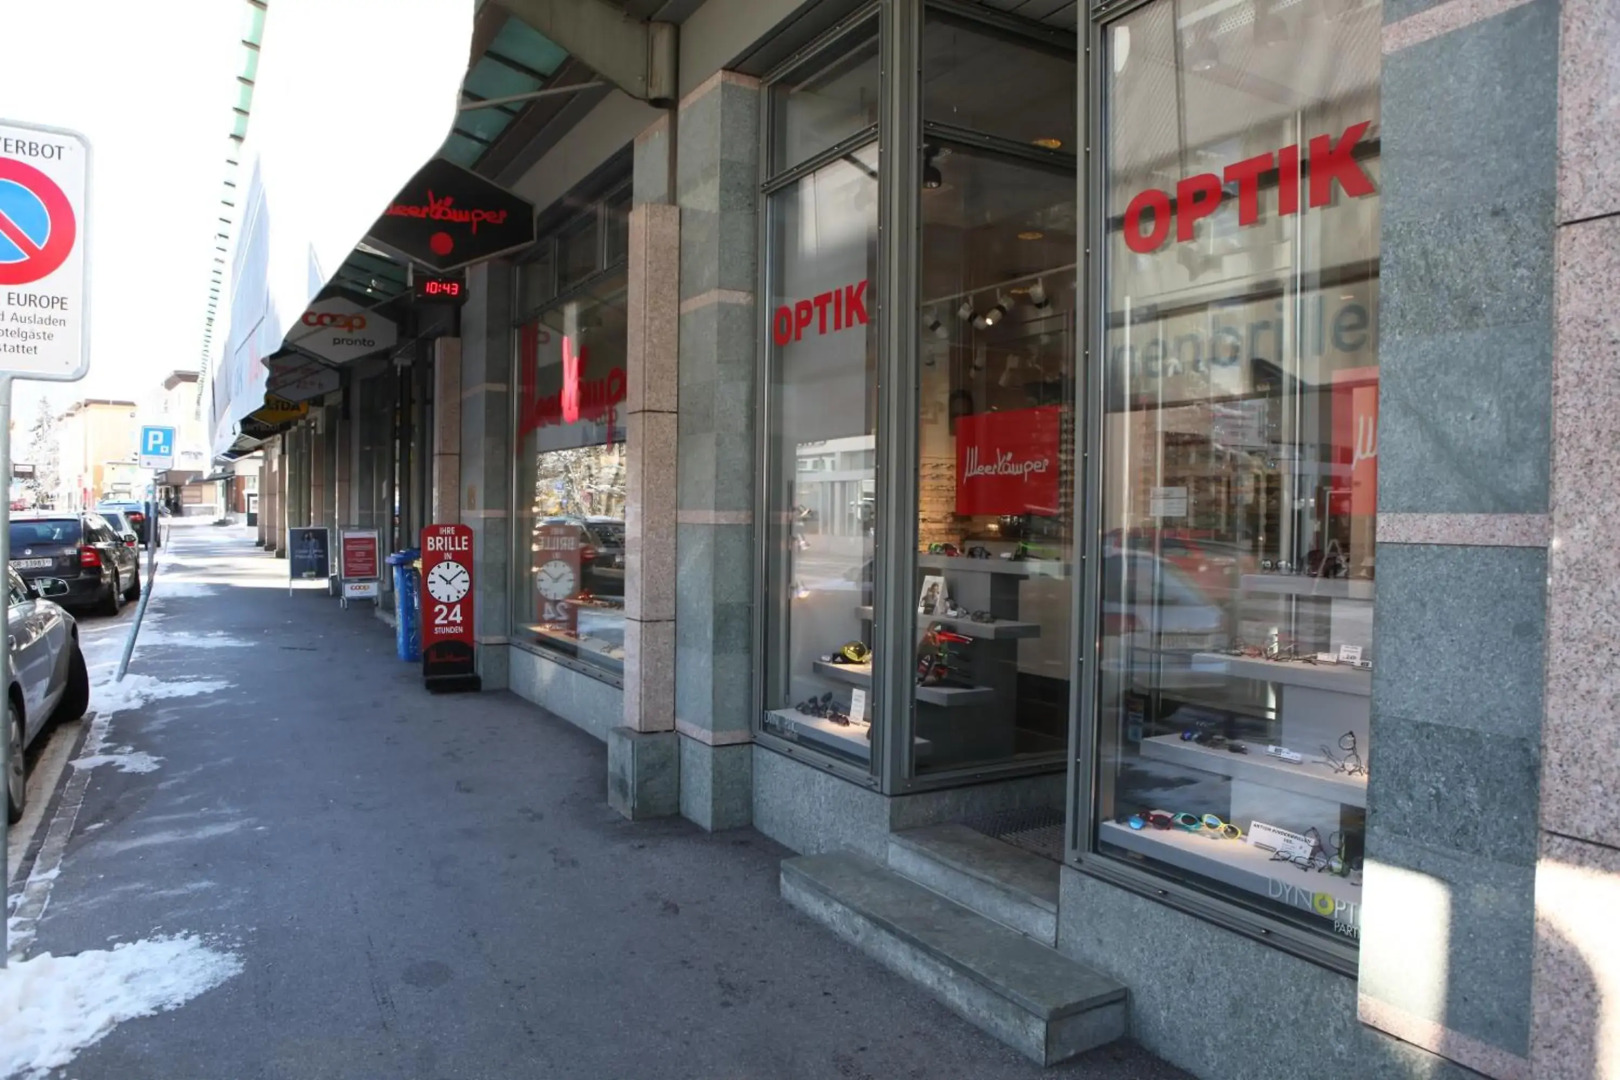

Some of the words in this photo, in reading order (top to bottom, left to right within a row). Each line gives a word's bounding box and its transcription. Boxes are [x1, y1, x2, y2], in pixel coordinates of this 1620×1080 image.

[0, 136, 65, 160] ERBOT
[1123, 120, 1376, 254] OPTIK
[425, 281, 460, 296] 10:43
[7, 292, 69, 311] EUROPE
[10, 312, 66, 327] Ausladen
[772, 279, 869, 346] OPTIK
[0, 343, 38, 355] tattet
[332, 336, 376, 348] pronto
[147, 430, 163, 452] P
[440, 527, 455, 535] IHRE
[427, 536, 469, 551] BRILLE
[434, 604, 463, 625] 24
[435, 627, 463, 635] STUNDEN
